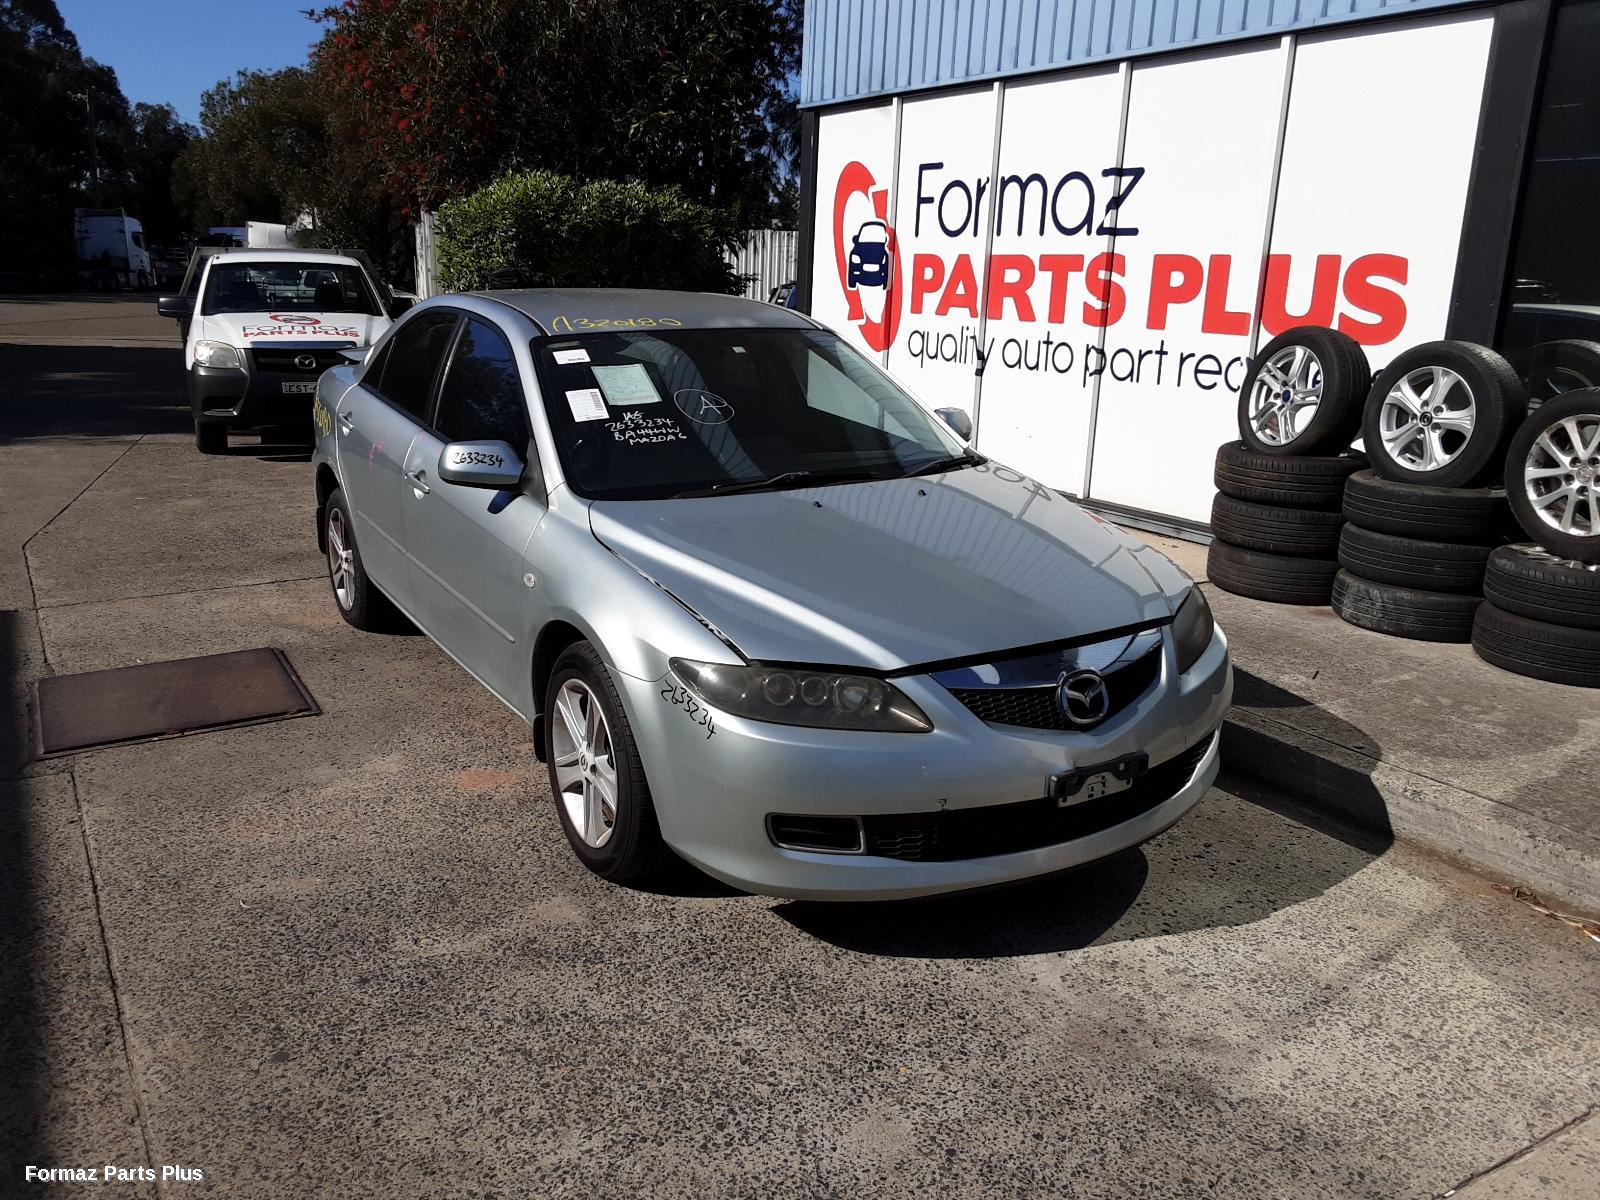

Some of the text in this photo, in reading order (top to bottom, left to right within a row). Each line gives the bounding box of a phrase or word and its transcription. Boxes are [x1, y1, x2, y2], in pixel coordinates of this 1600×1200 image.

[914, 162, 1145, 237] Formaz
[910, 252, 1409, 346] PARTS PLUS
[242, 324, 357, 333] Formaz
[243, 330, 360, 338] PARTS PLUS
[907, 325, 995, 376] quality
[1001, 330, 1074, 374] auto
[1083, 339, 1169, 388] part
[604, 418, 675, 432] 2633234
[453, 452, 505, 468] 2633234
[661, 679, 716, 740] 2633234
